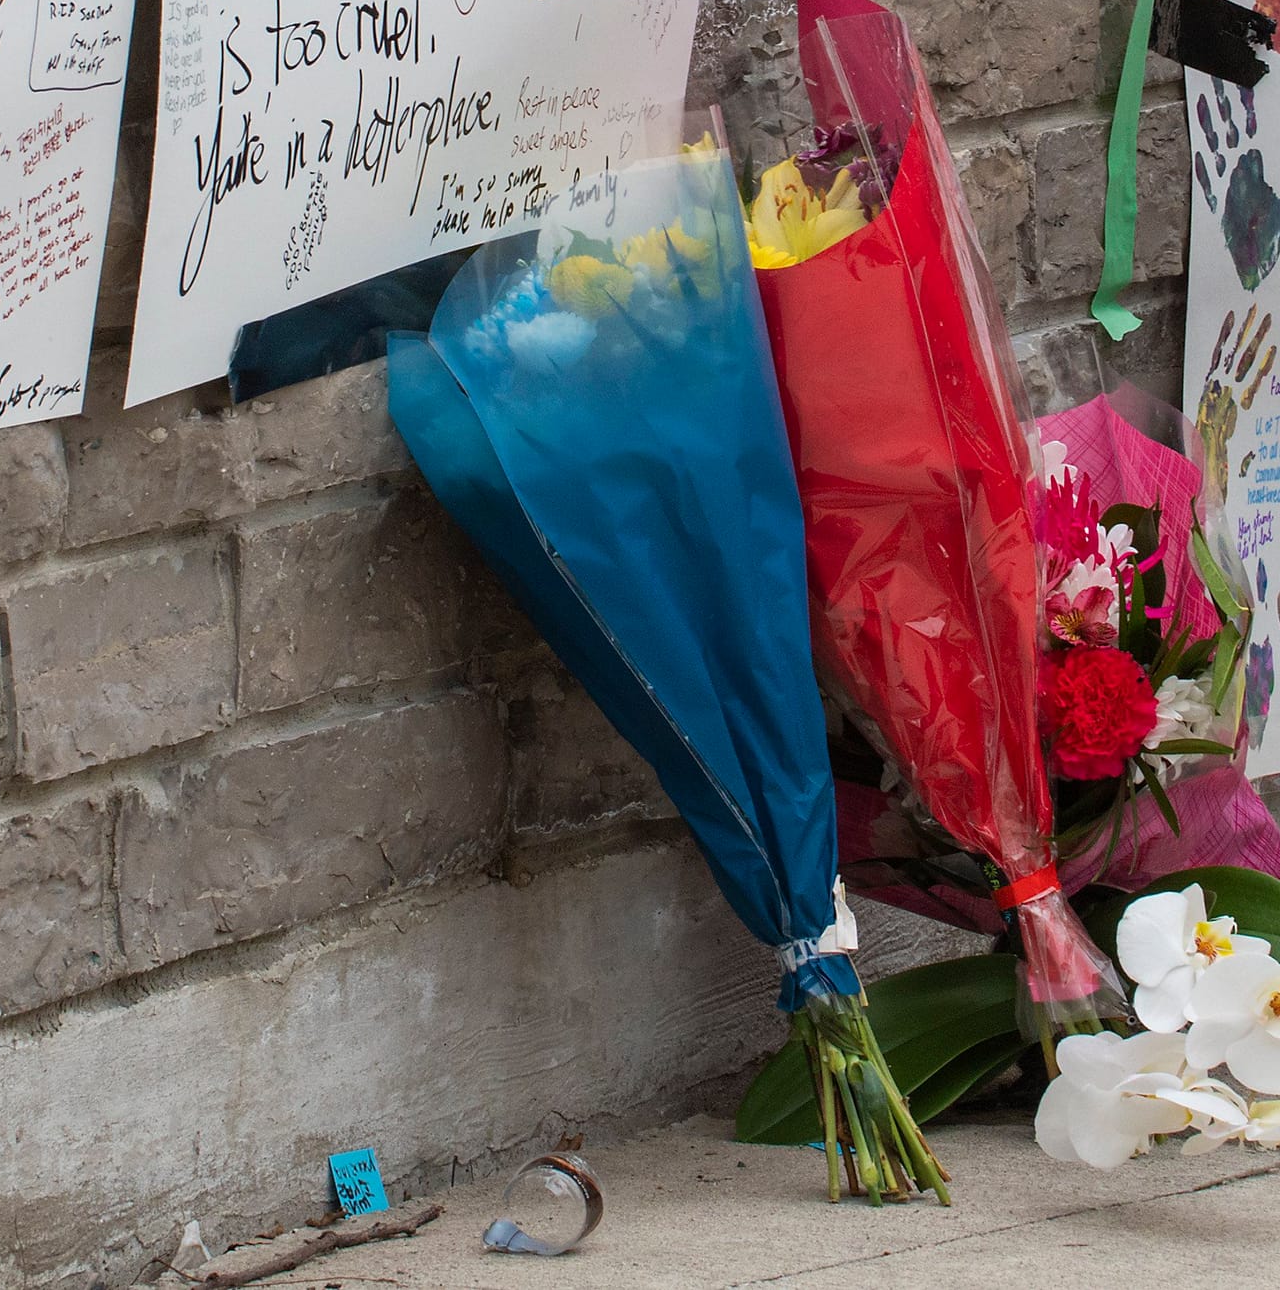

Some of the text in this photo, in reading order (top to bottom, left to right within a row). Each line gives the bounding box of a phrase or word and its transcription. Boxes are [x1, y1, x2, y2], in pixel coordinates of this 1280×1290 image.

[219, 10, 253, 104] is
[515, 76, 546, 122] Rest
[285, 118, 308, 189] in
[319, 119, 334, 165] a
